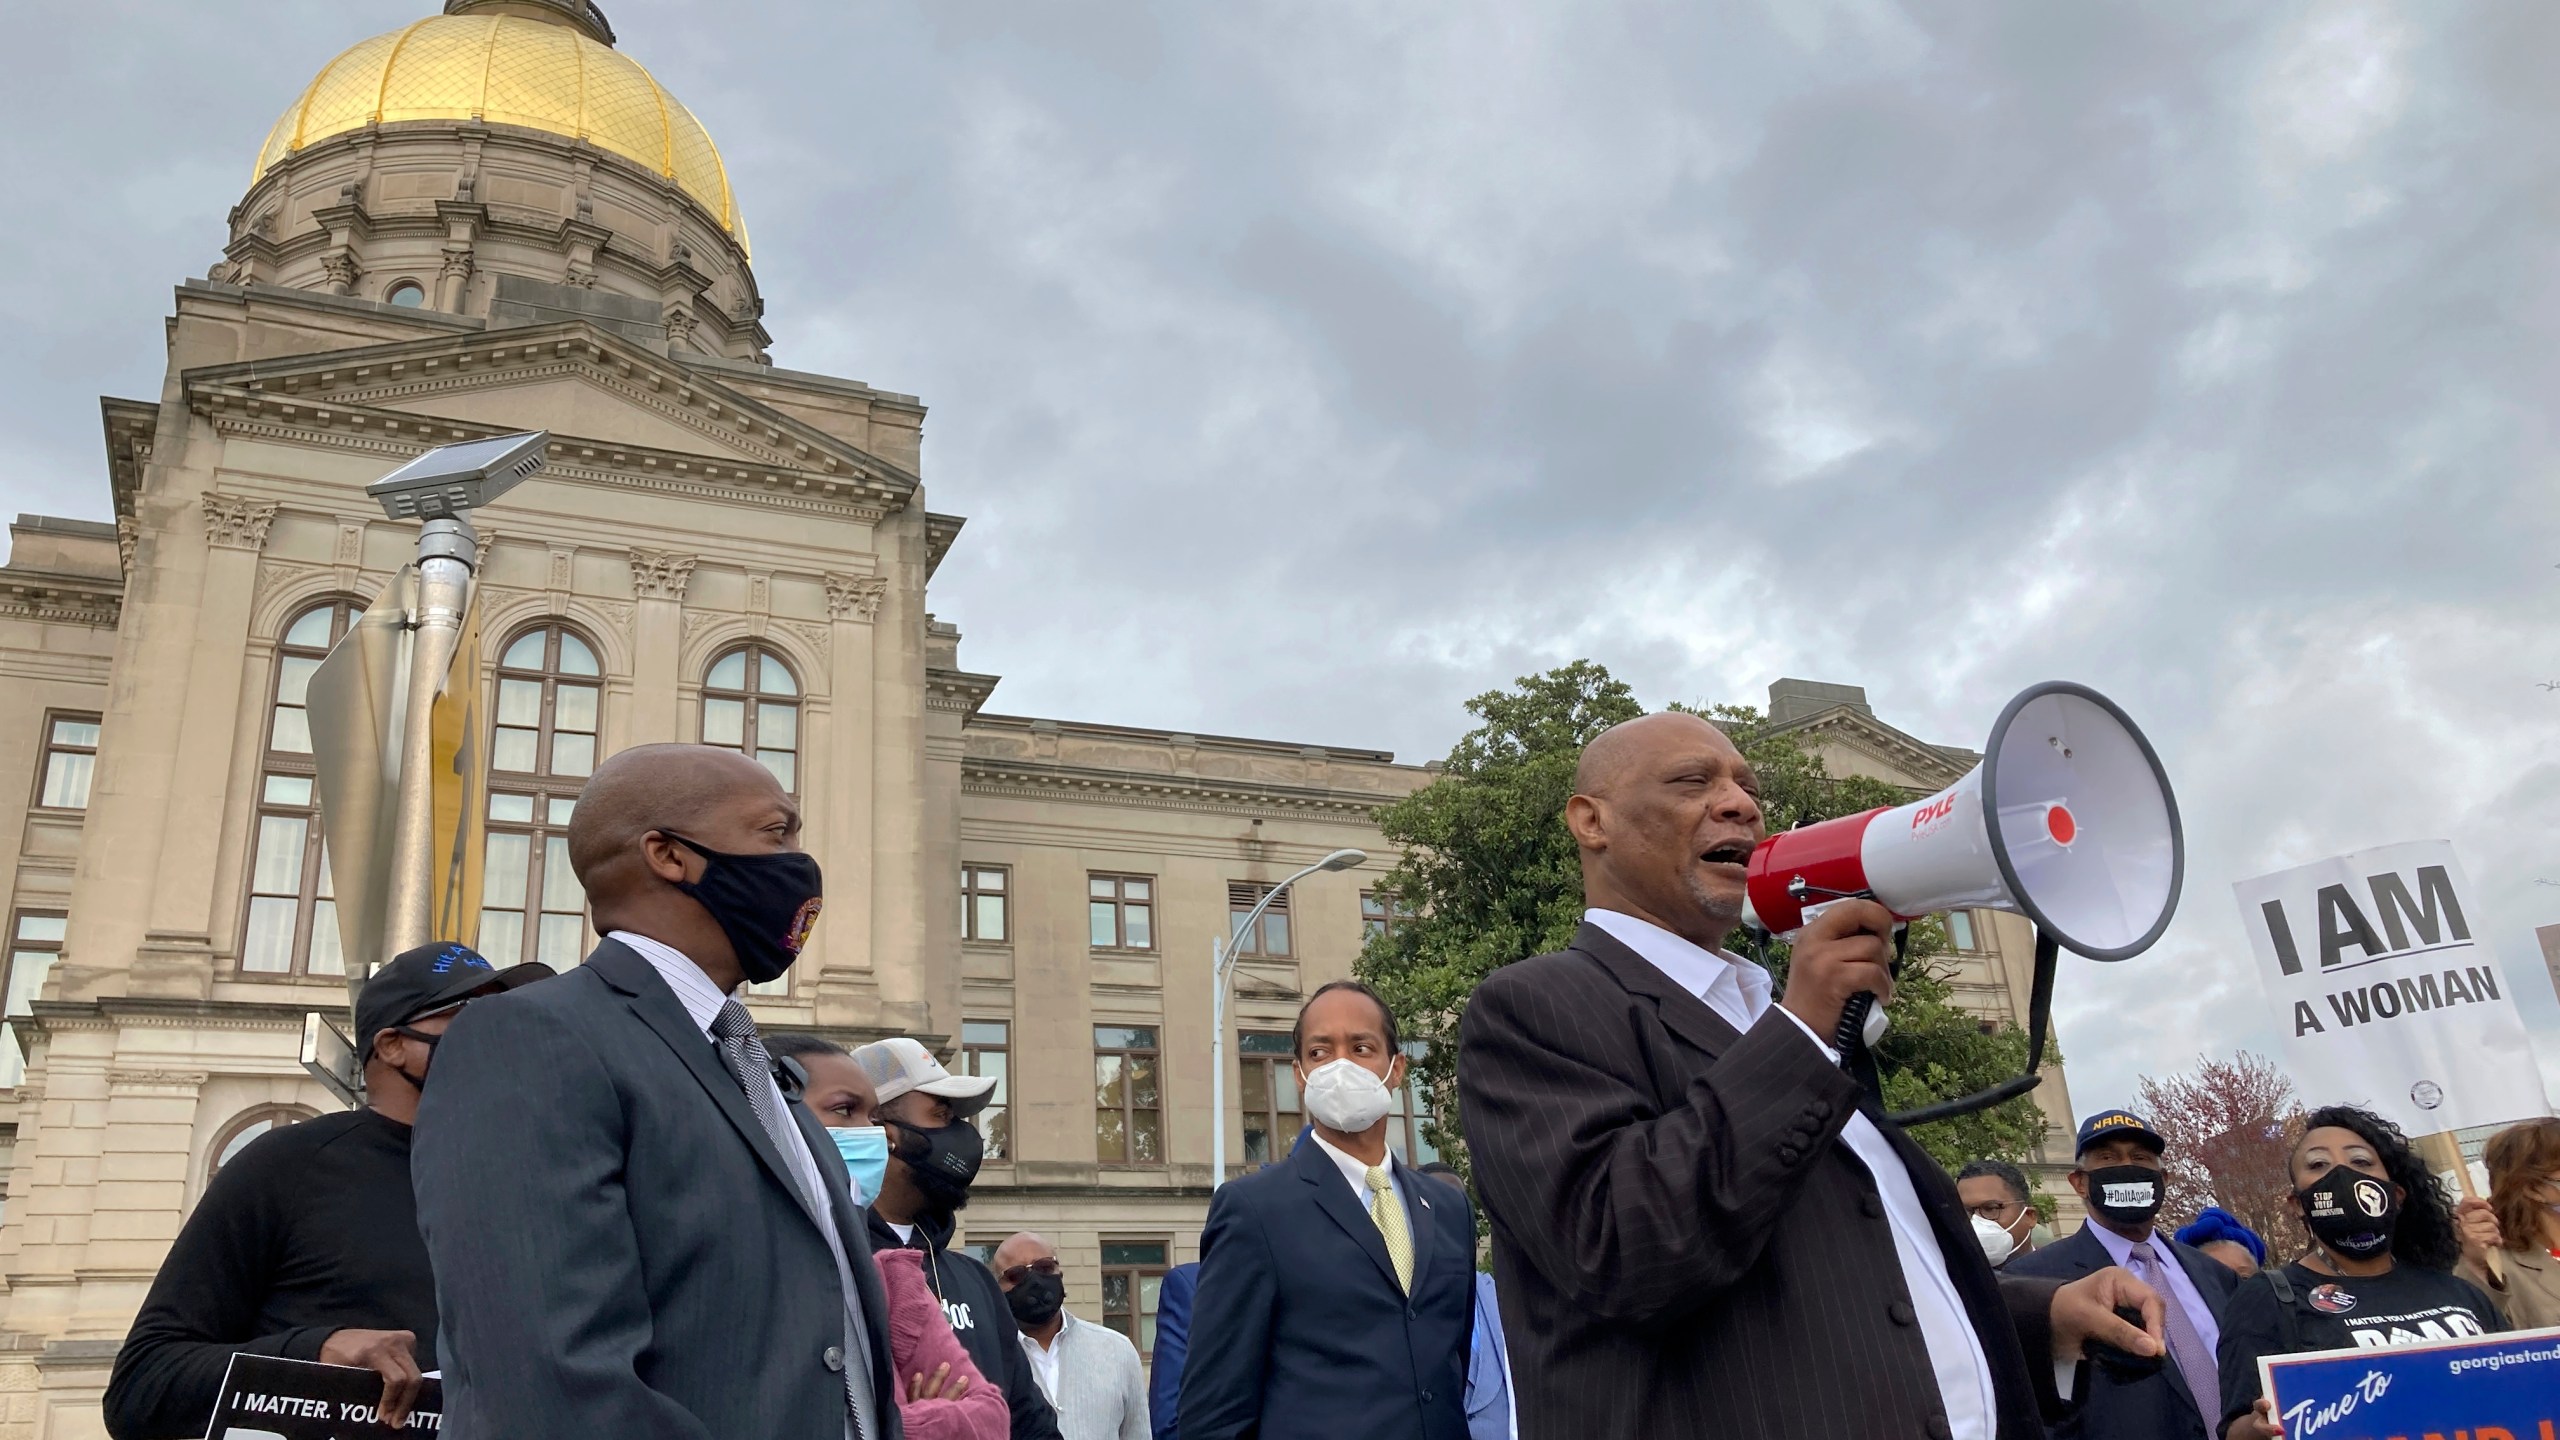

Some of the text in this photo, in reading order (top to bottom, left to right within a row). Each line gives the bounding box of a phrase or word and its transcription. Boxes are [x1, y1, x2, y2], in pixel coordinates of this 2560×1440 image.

[1912, 791, 1957, 829] PYLE
[2261, 865, 2471, 976] I AM
[2295, 966, 2501, 1037] A WOMAN
[2093, 1114, 2145, 1130] NAACP
[2106, 1188, 2151, 1203] #DoItAgain
[2313, 1192, 2333, 1201] STOP
[2313, 1200, 2333, 1209] VOTER
[2384, 1314, 2405, 1322] YOU
[2449, 1343, 2560, 1375] georgiastand
[231, 1391, 443, 1430] I MATTER. YOU ATT
[2282, 1391, 2358, 1440] Time
[2355, 1370, 2392, 1404] to
